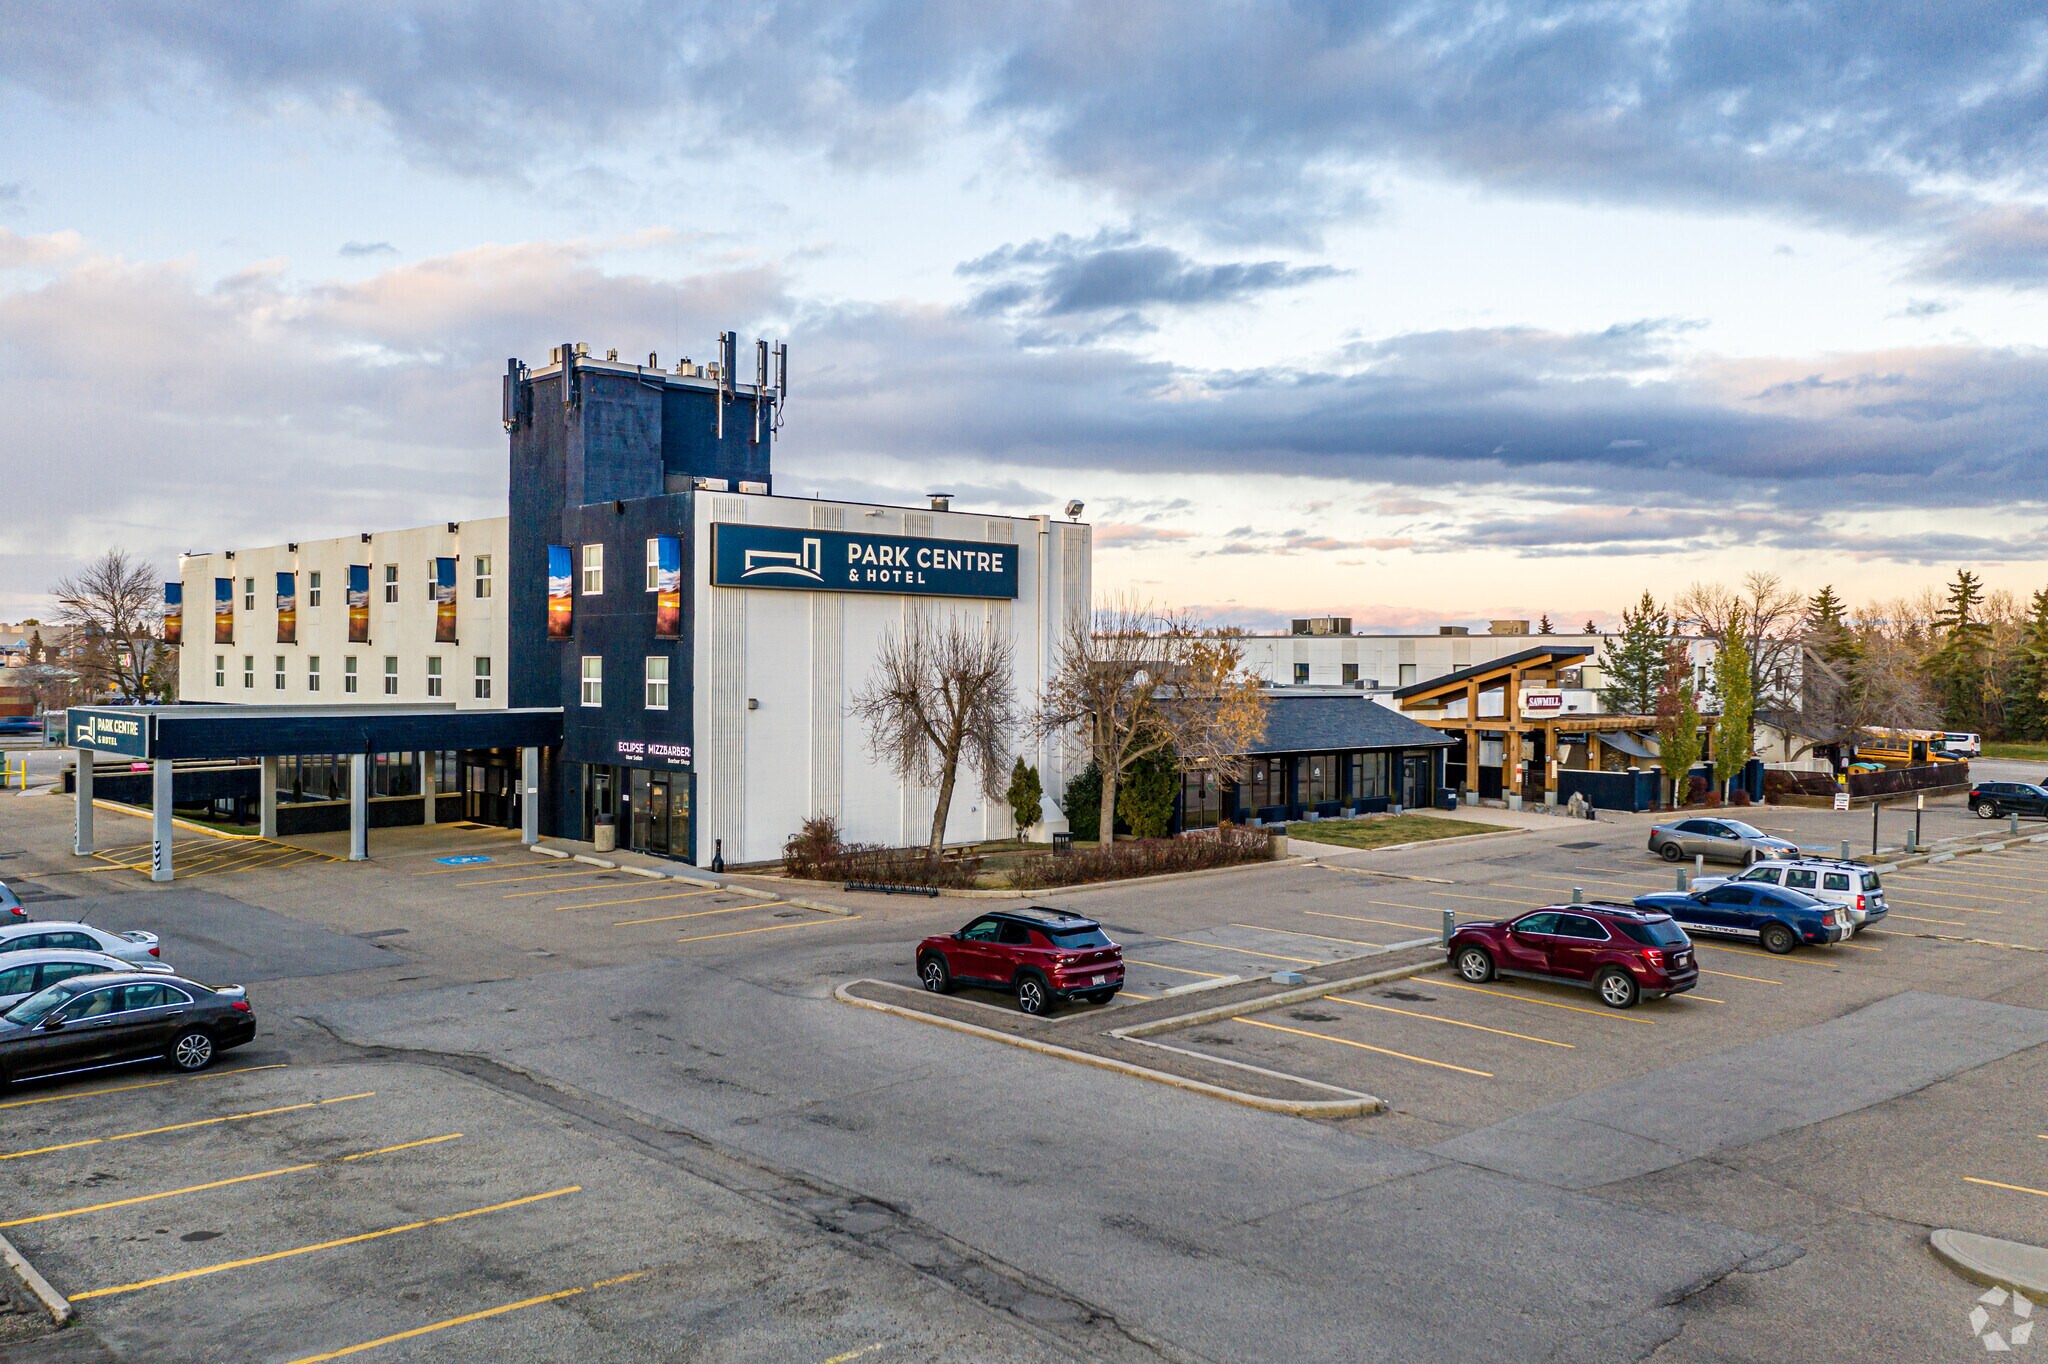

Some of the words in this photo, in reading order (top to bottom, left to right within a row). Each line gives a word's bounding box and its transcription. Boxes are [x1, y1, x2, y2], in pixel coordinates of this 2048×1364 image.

[848, 543, 910, 567] PARK
[916, 547, 1004, 573] CENTRE
[849, 568, 860, 582] &
[866, 569, 926, 584] HOTEL
[1529, 697, 1560, 706] SAWMILL
[98, 718, 114, 732] PARK
[114, 720, 138, 736] CENTRE
[102, 736, 118, 746] HOTEL
[618, 742, 645, 754] ECLIPSE
[648, 744, 691, 757] MIZZBARBER
[1694, 924, 1738, 932] MUSTANG
